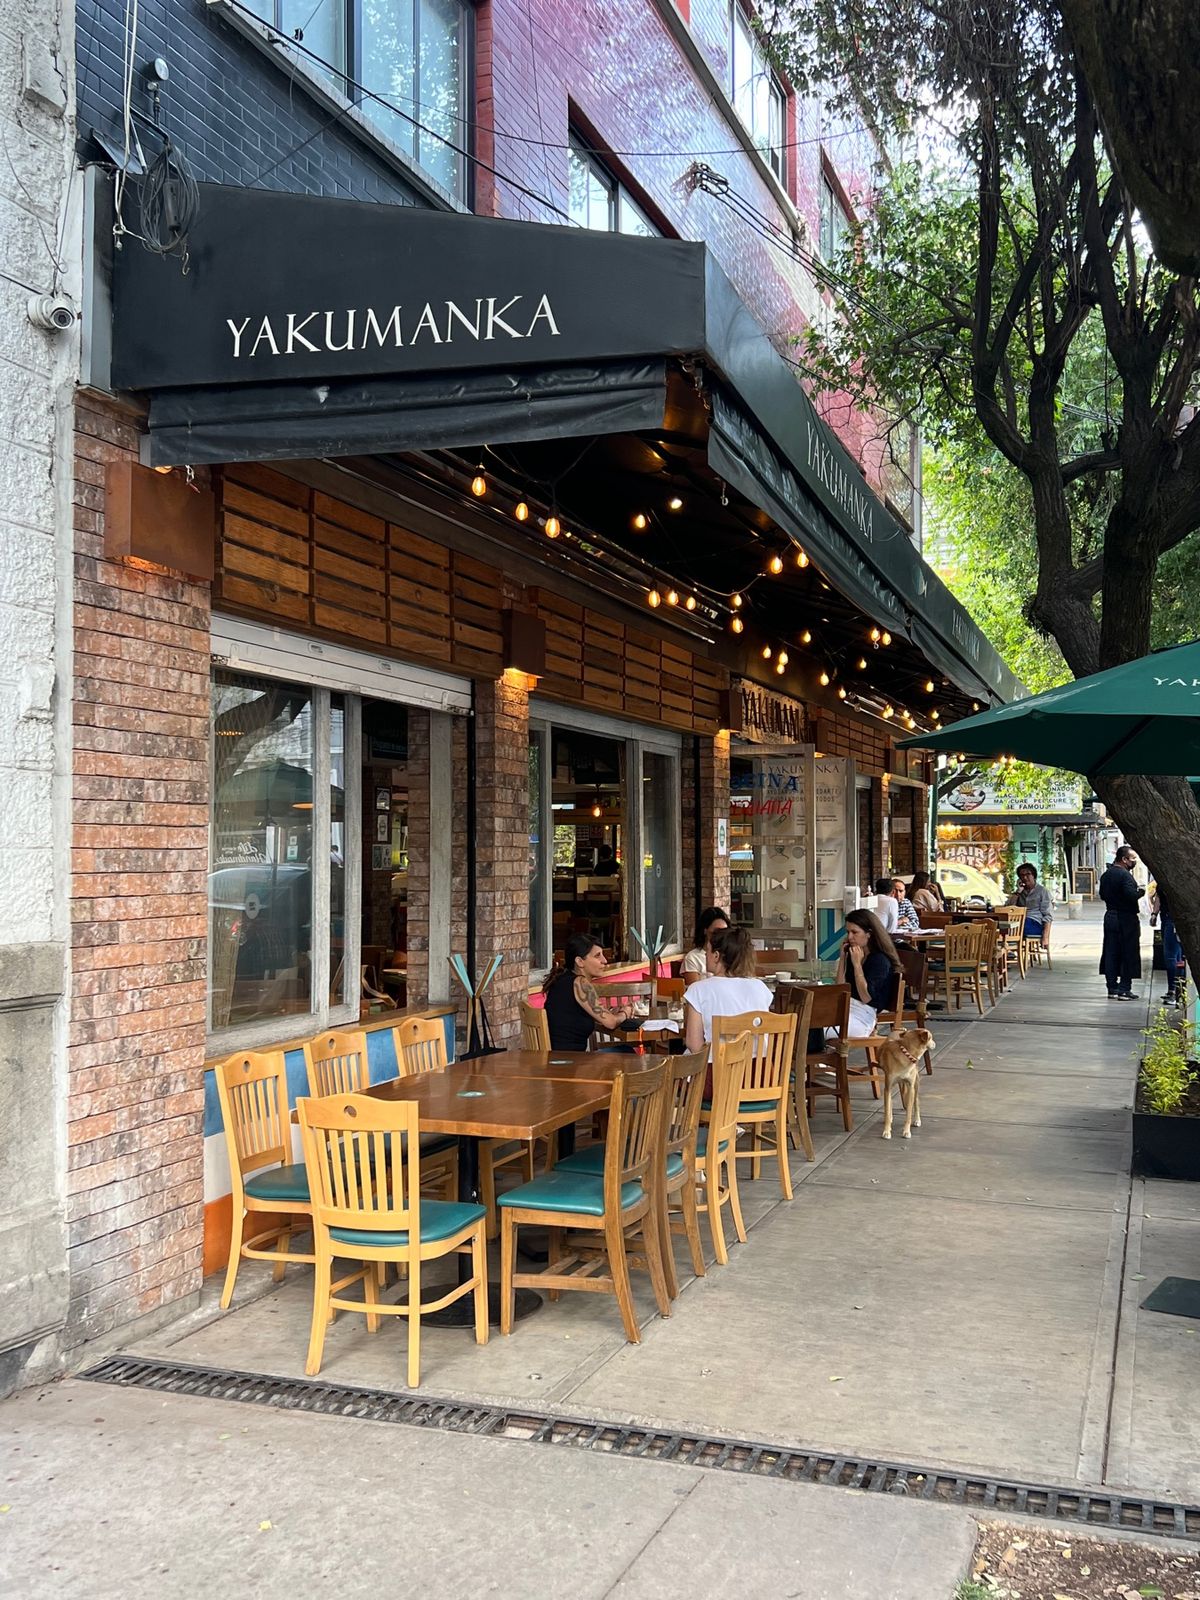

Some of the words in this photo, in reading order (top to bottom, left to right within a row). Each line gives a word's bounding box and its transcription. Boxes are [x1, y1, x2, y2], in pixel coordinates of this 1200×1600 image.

[226, 293, 561, 358] YAKUMANKA
[806, 420, 874, 544] YAKUMANKA
[945, 846, 985, 859] HAIR
[949, 855, 985, 868] UTS
